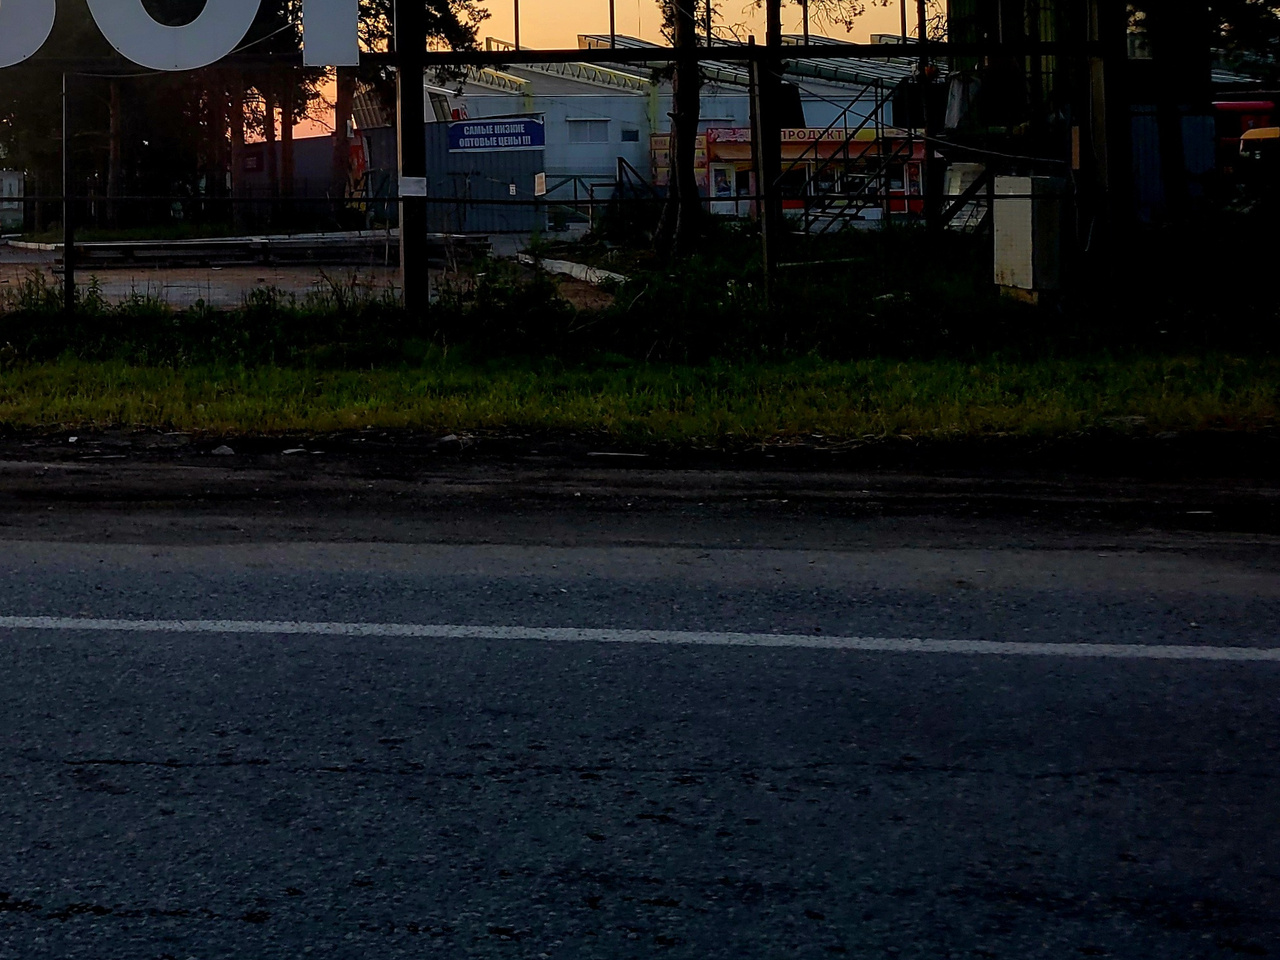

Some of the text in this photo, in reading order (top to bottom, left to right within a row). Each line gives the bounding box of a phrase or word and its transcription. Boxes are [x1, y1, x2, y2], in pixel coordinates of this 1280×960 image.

[463, 124, 525, 135] САМЫЕ НИЗКИЕ
[780, 129, 855, 140] ПРОДУКТ
[459, 137, 497, 147] ОПТОВЫЕ
[498, 136, 521, 146] ЦЕНЫ
